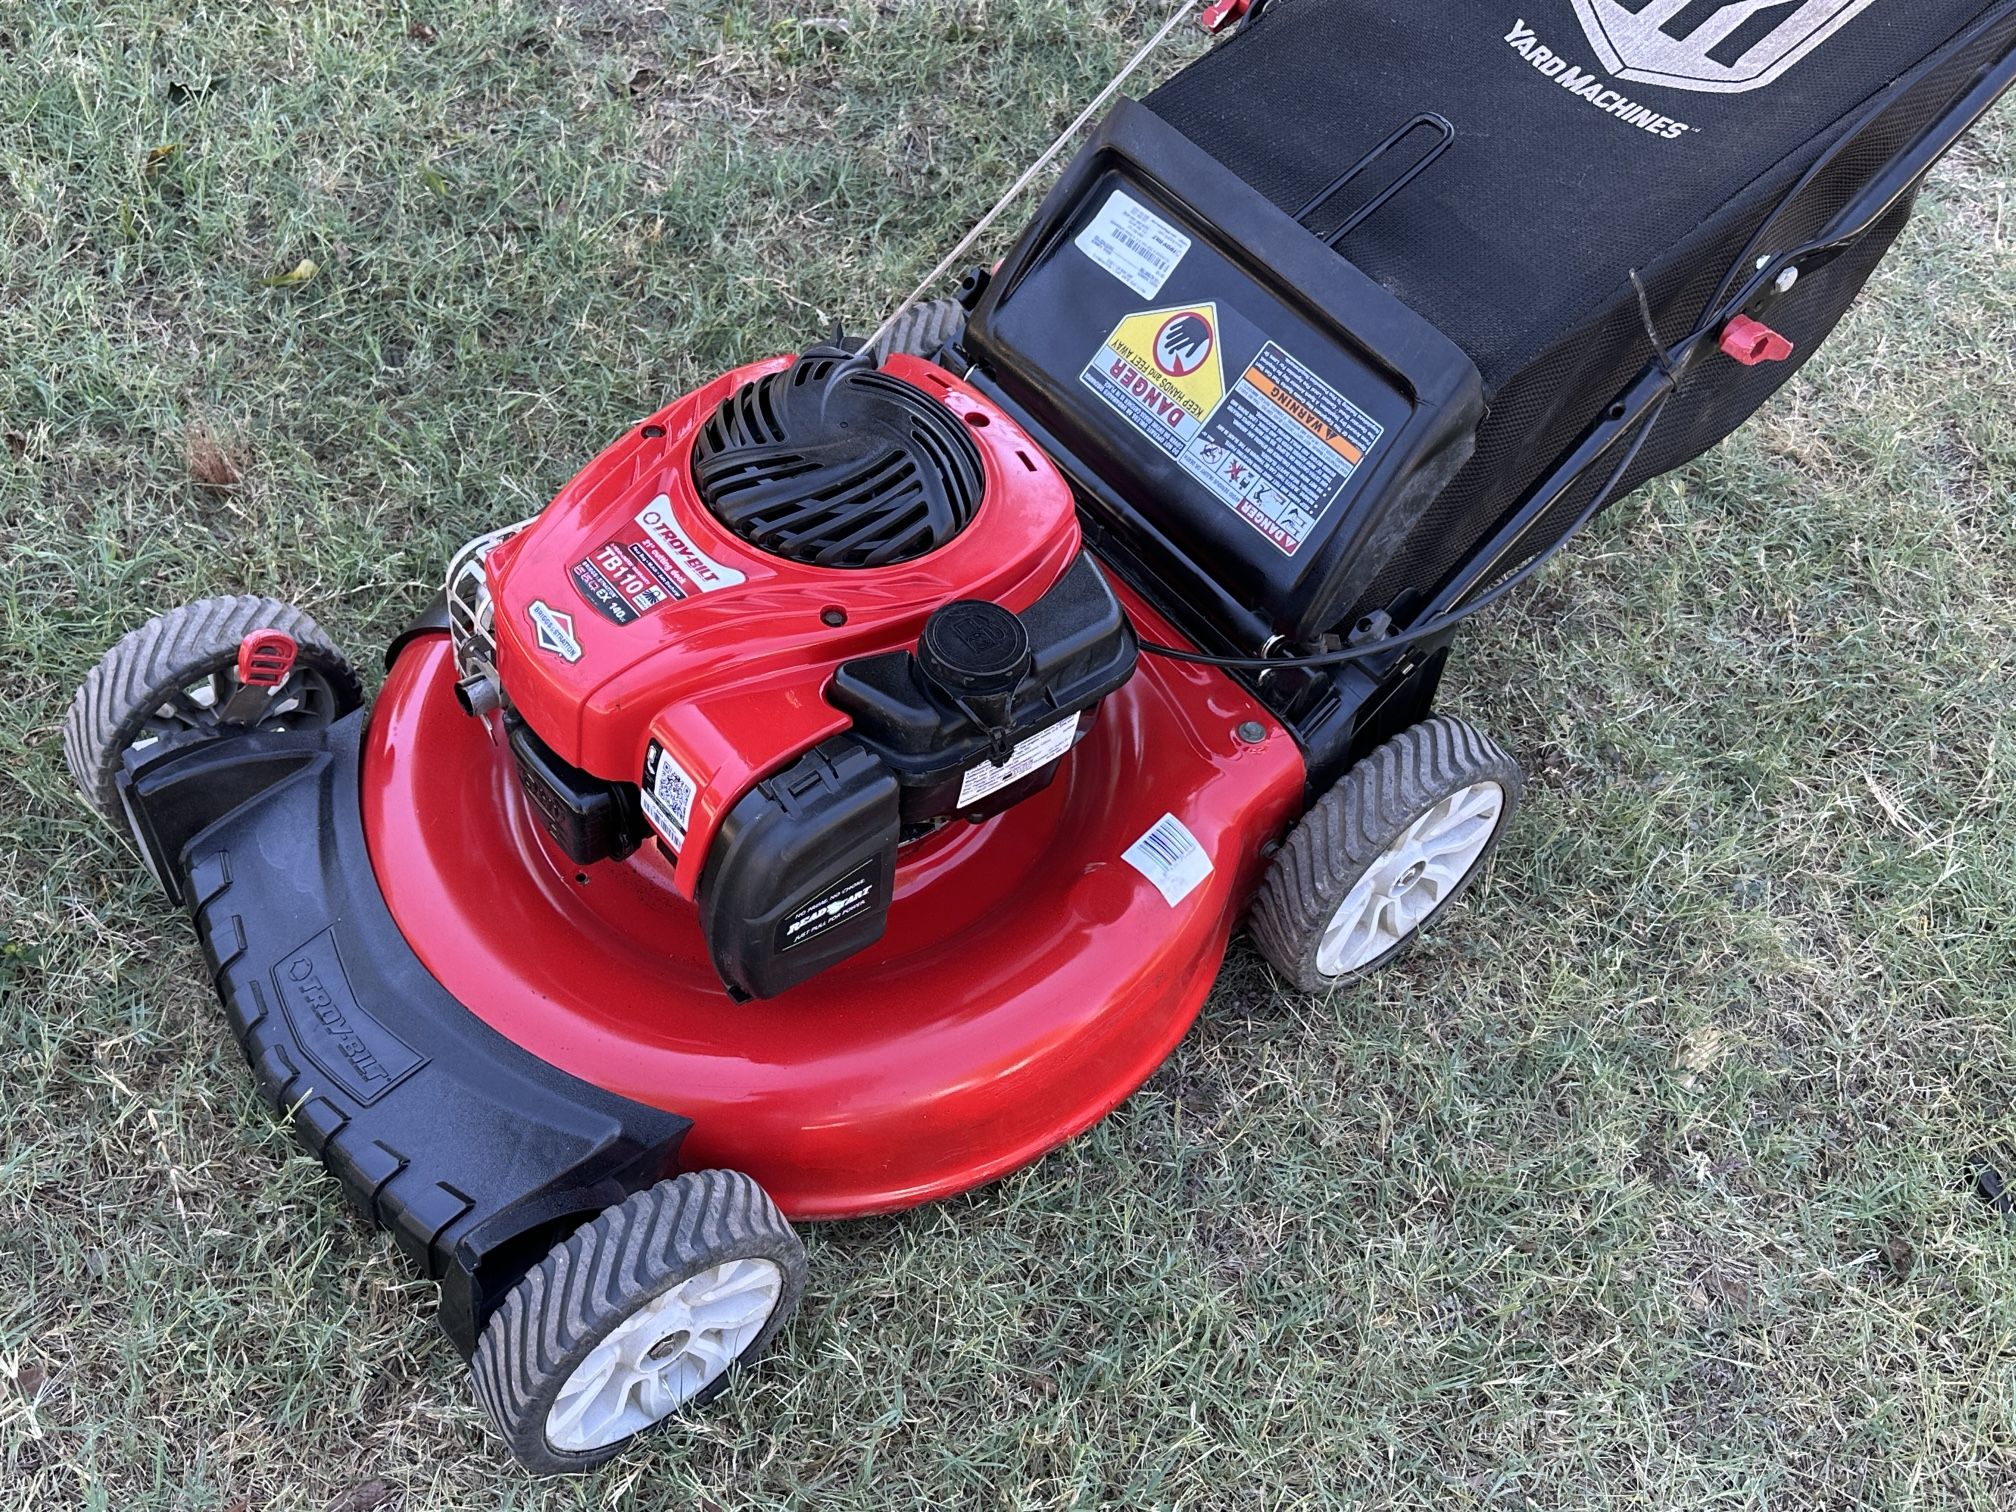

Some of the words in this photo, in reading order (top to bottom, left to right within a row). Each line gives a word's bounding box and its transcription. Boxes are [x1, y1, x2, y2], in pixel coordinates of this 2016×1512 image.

[1504, 18, 1567, 76] YARD
[1111, 336, 1133, 359] AWAY
[1130, 353, 1150, 373] FEET
[1147, 367, 1162, 383] and
[1158, 376, 1185, 403] HANDS
[1110, 359, 1184, 428] DANGER
[1181, 396, 1203, 418] KEEP
[1269, 386, 1323, 432] WARNING
[1146, 425, 1165, 443] OPERATE
[1163, 439, 1173, 450] NOT
[1239, 500, 1285, 542] DANGER
[596, 546, 643, 594] TB110
[647, 548, 675, 571] cutting
[668, 568, 688, 584] deck
[652, 521, 719, 584] TROY-BILT
[299, 976, 389, 1082] TROY-BILT
